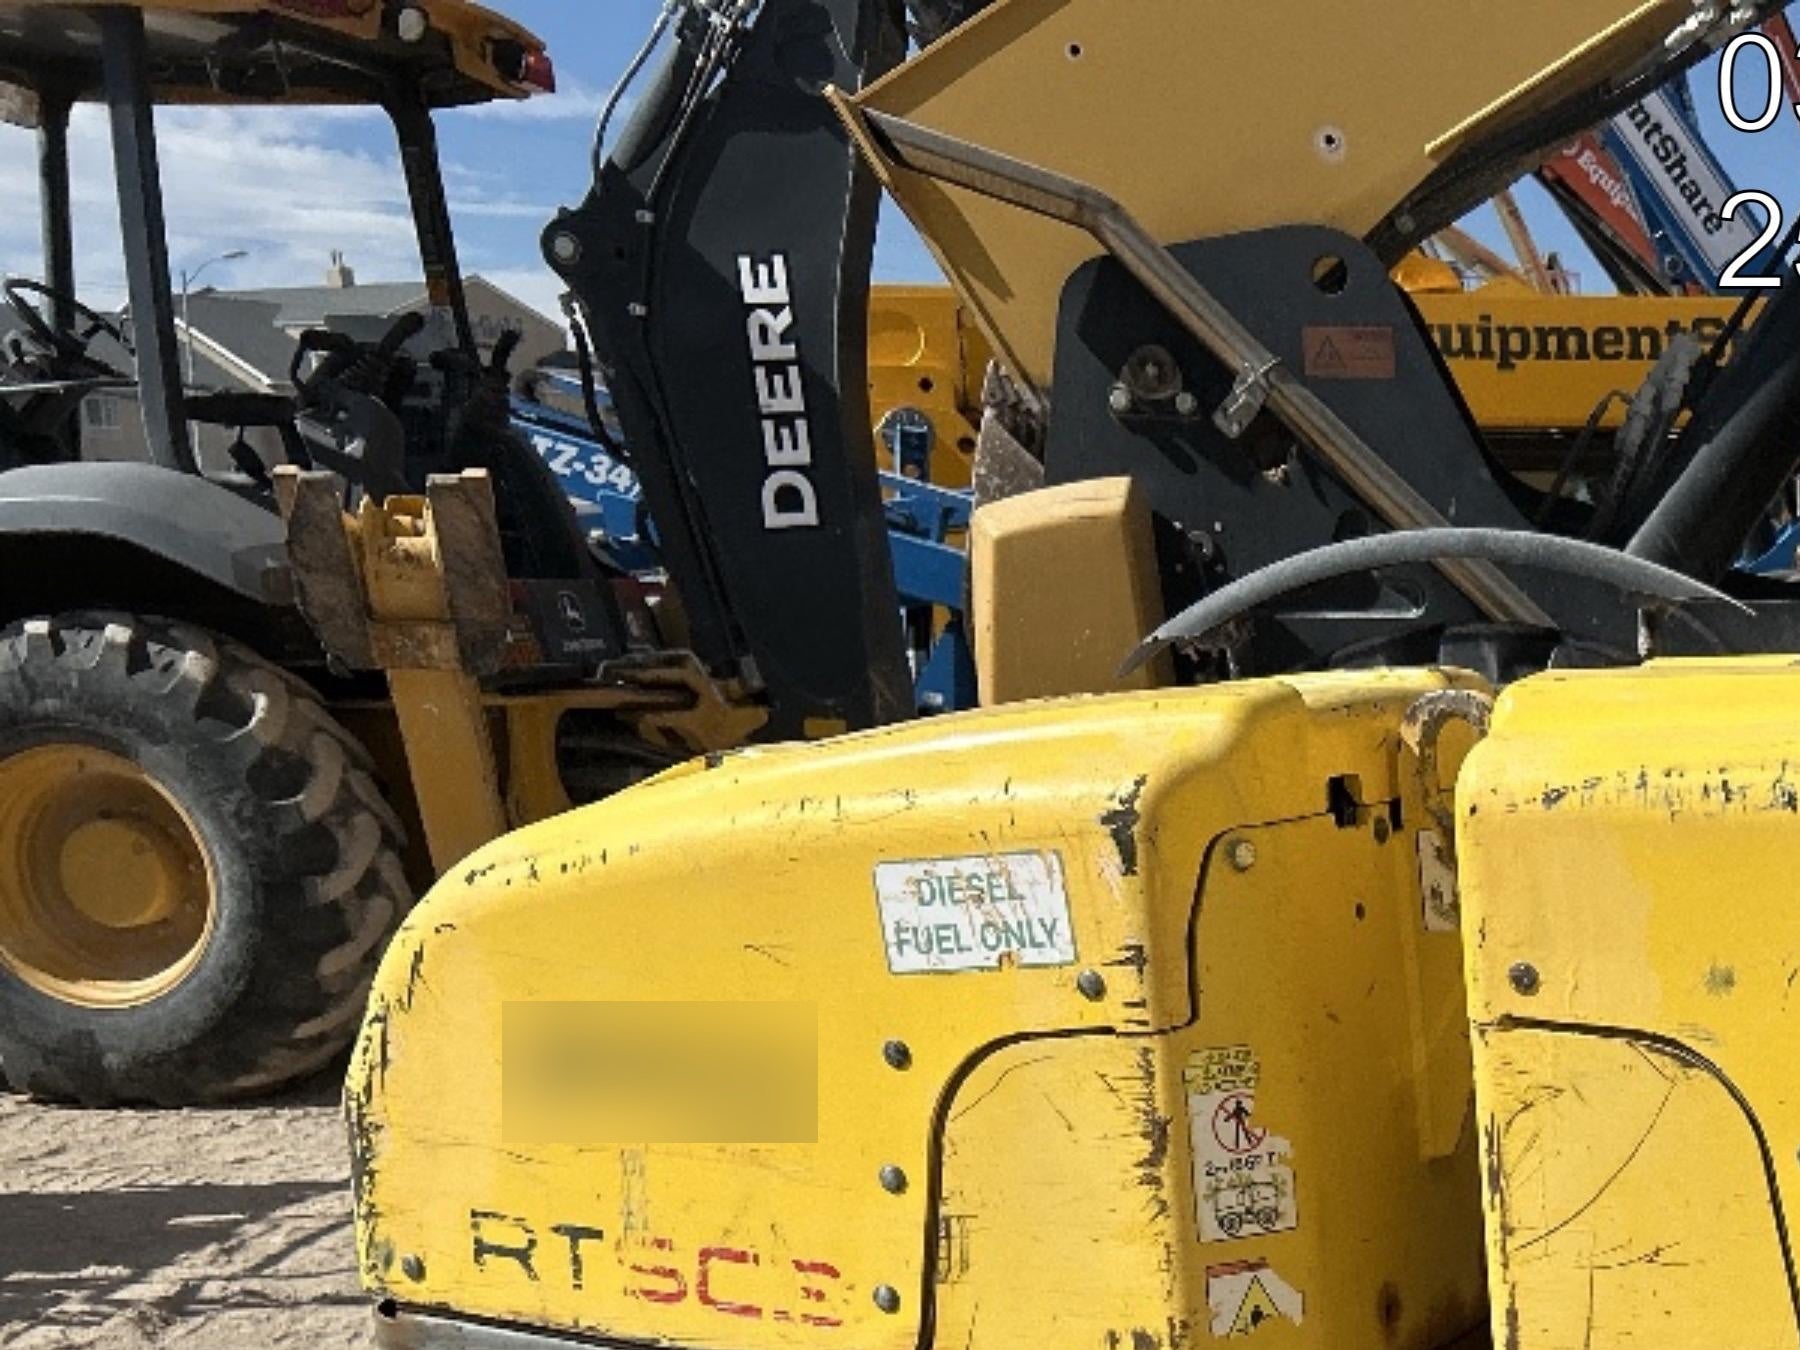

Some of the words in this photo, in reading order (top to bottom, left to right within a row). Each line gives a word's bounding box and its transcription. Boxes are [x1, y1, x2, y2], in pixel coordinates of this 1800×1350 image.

[737, 254, 820, 529] DEERE
[916, 872, 1026, 907] DIESEL
[894, 920, 973, 957] FUEL
[980, 917, 1059, 950] ONLY
